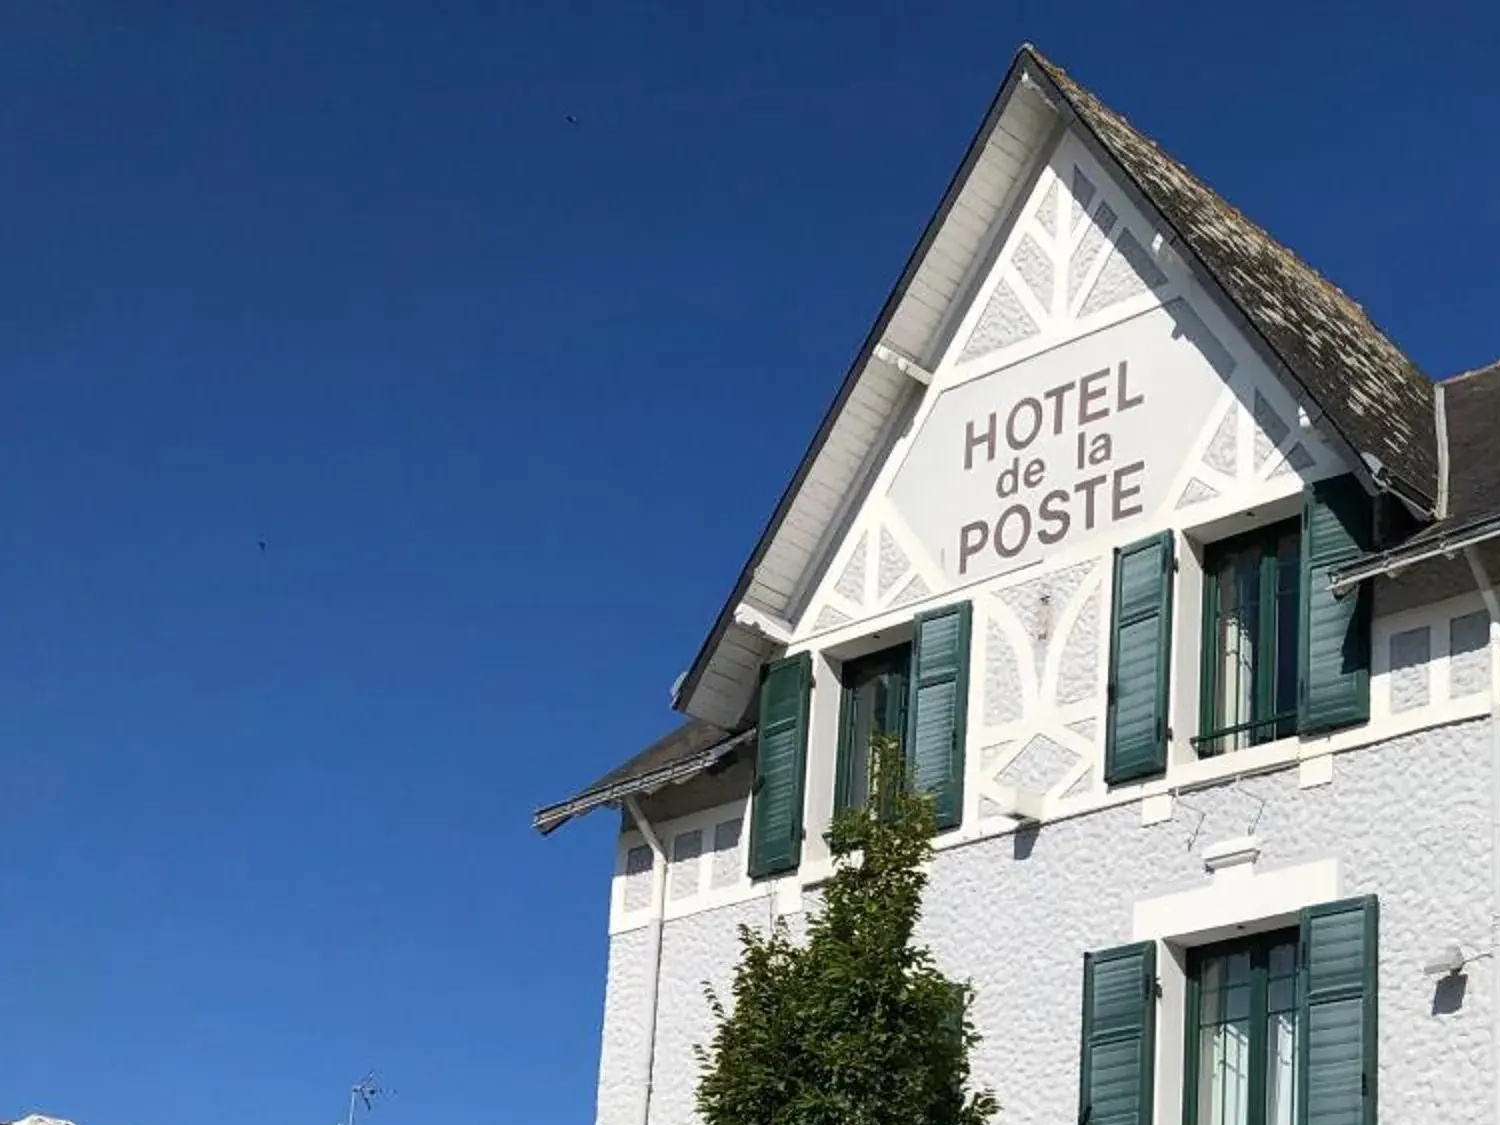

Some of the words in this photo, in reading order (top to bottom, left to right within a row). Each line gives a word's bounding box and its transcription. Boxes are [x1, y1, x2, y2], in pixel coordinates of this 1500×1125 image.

[963, 360, 1145, 470] HOTEL
[996, 456, 1046, 499] de
[1076, 431, 1113, 470] la
[958, 460, 1145, 575] POSTE
